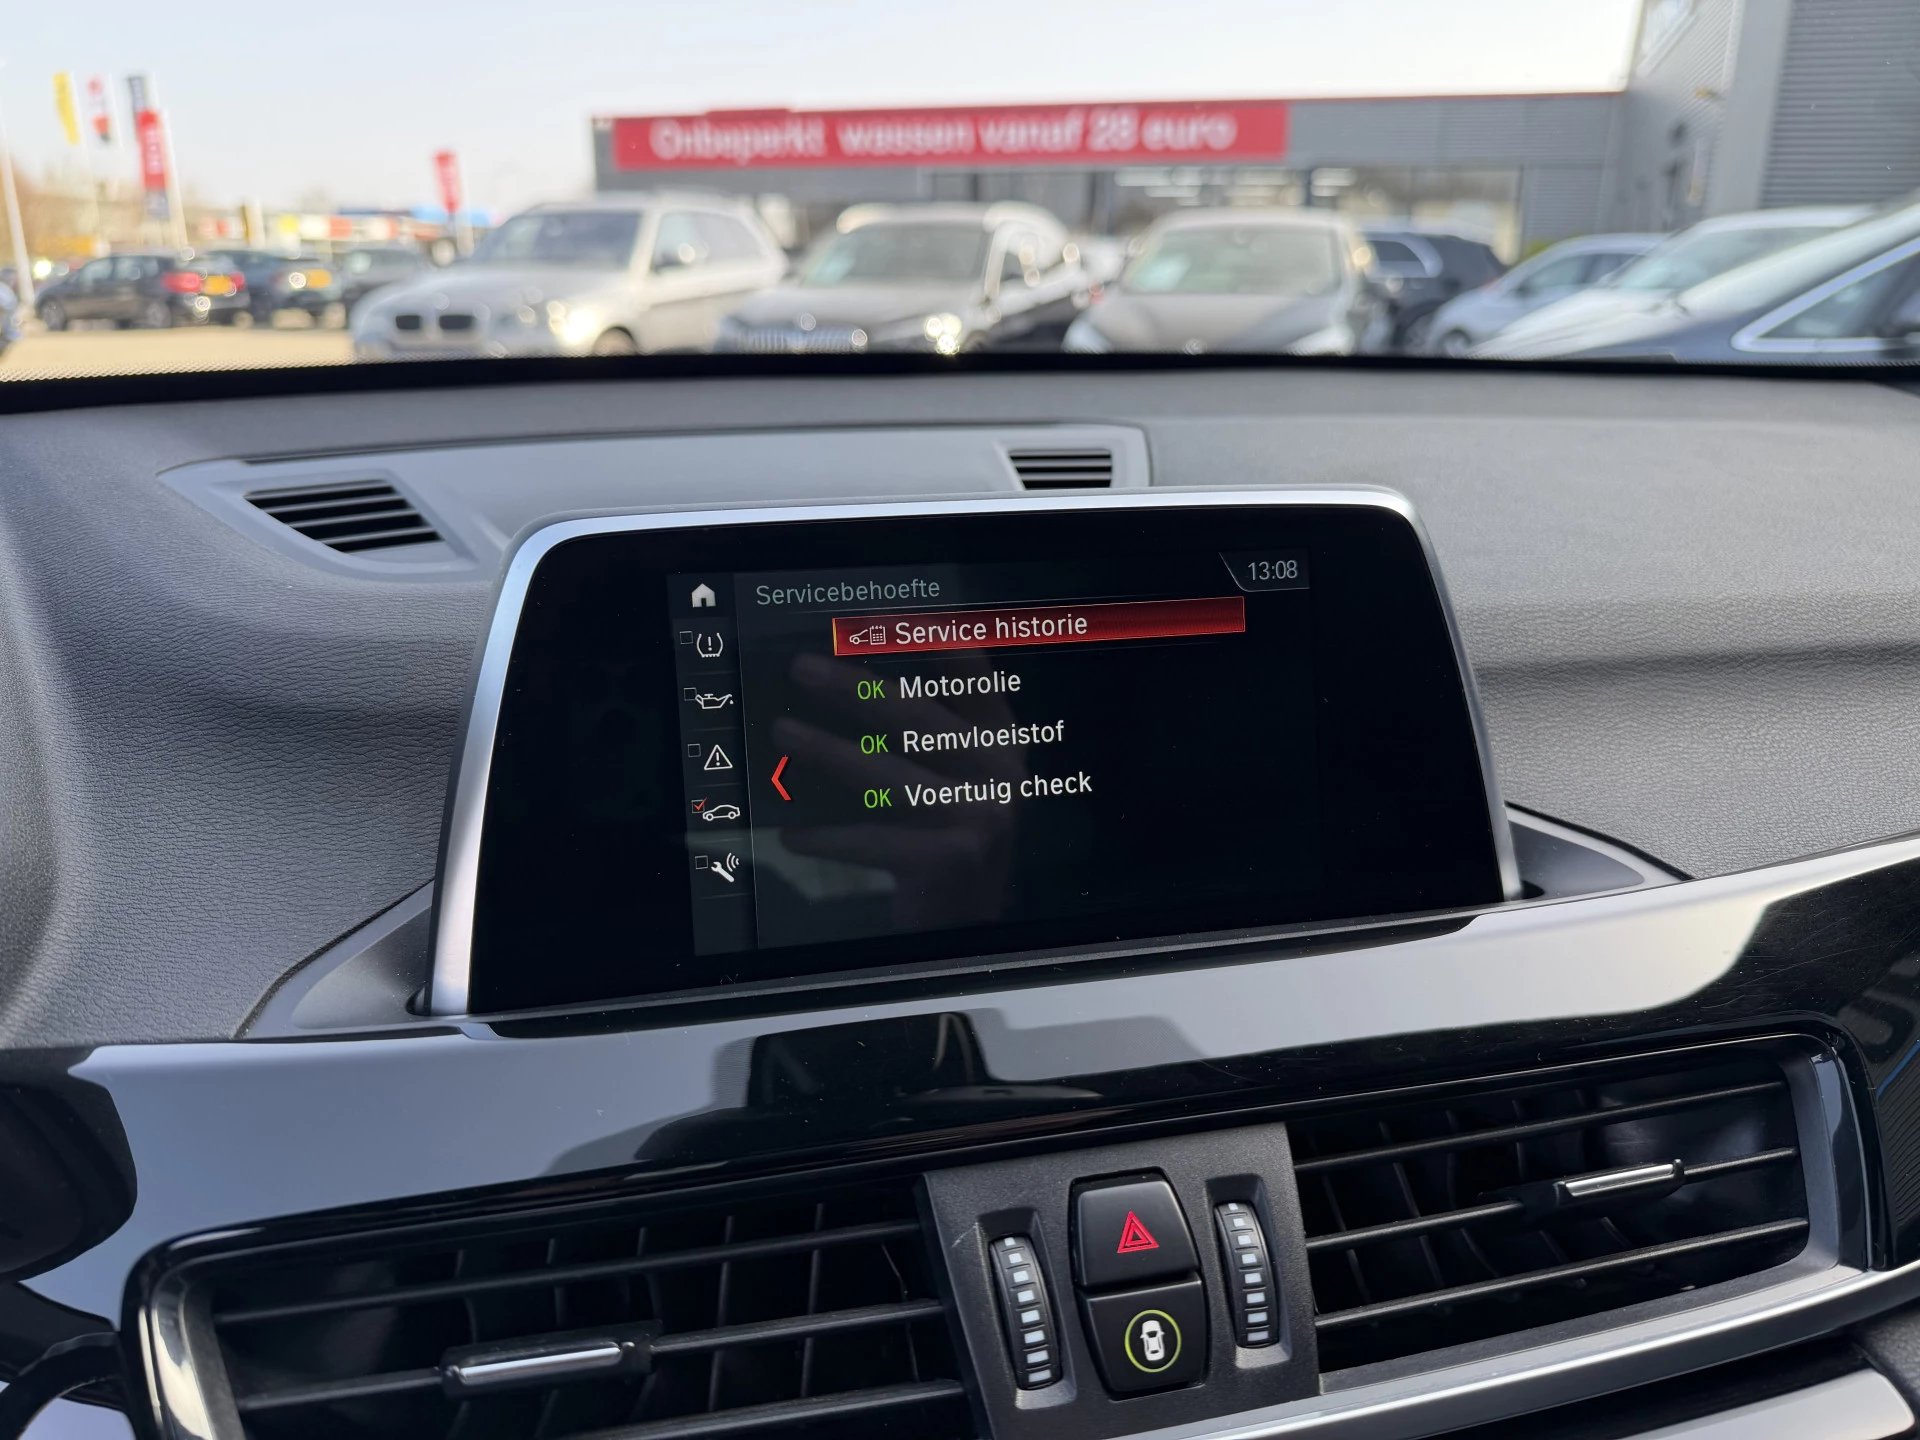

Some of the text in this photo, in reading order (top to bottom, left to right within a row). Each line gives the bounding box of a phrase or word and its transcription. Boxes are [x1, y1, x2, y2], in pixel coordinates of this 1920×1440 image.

[840, 121, 973, 157] wassen
[979, 110, 1083, 153] vanaf
[1142, 111, 1236, 150] euro
[1247, 560, 1298, 581] 13:08
[755, 579, 940, 605] Servicebehoefte
[895, 614, 1088, 645] Service historie
[857, 672, 1022, 700] OK Motorolie
[860, 720, 1065, 754] OK Remvloeistof
[864, 771, 1093, 808] OK Voertuig check
